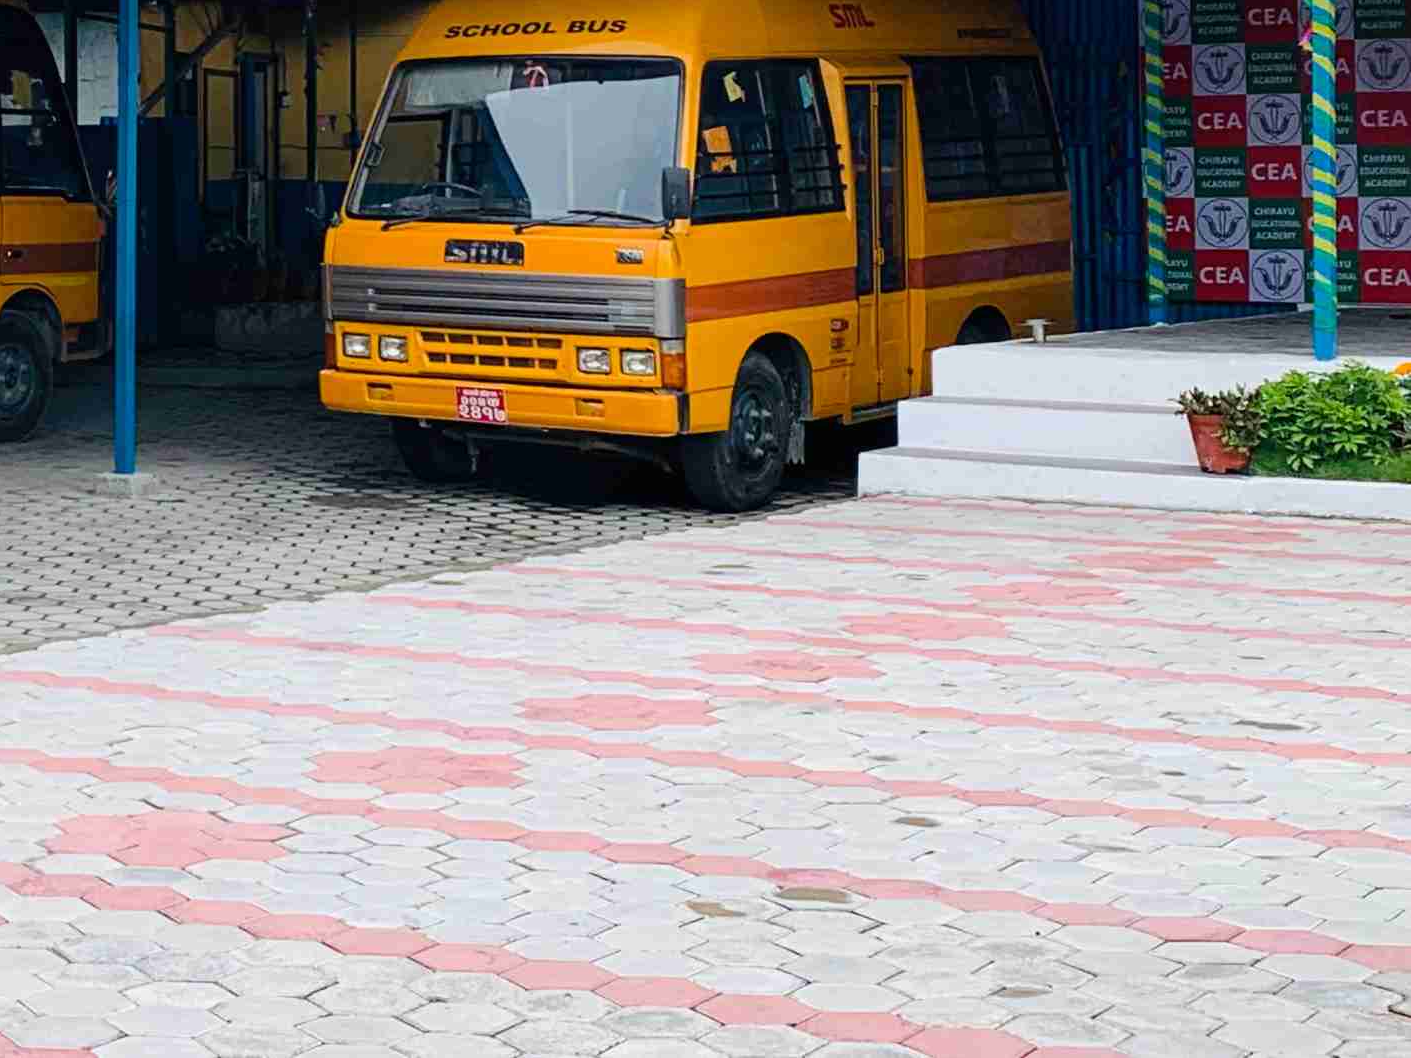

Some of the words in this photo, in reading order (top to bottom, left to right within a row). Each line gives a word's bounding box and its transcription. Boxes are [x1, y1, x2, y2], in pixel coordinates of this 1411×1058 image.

[829, 3, 875, 29] SML
[1248, 8, 1293, 25] CEA
[445, 21, 557, 39] SCHOOL
[567, 19, 627, 34] BUS
[1198, 112, 1242, 130] CEA
[1360, 110, 1407, 128] CEA
[1363, 154, 1405, 163] CHIRAYU
[1252, 163, 1297, 180] CEA
[1365, 179, 1407, 188] ACADEMY
[1254, 207, 1295, 215] CHIRAYU
[1166, 216, 1191, 232] EA
[1256, 231, 1296, 240] ACADEMY
[1200, 267, 1245, 284] CEA
[1364, 268, 1411, 286] CEA
